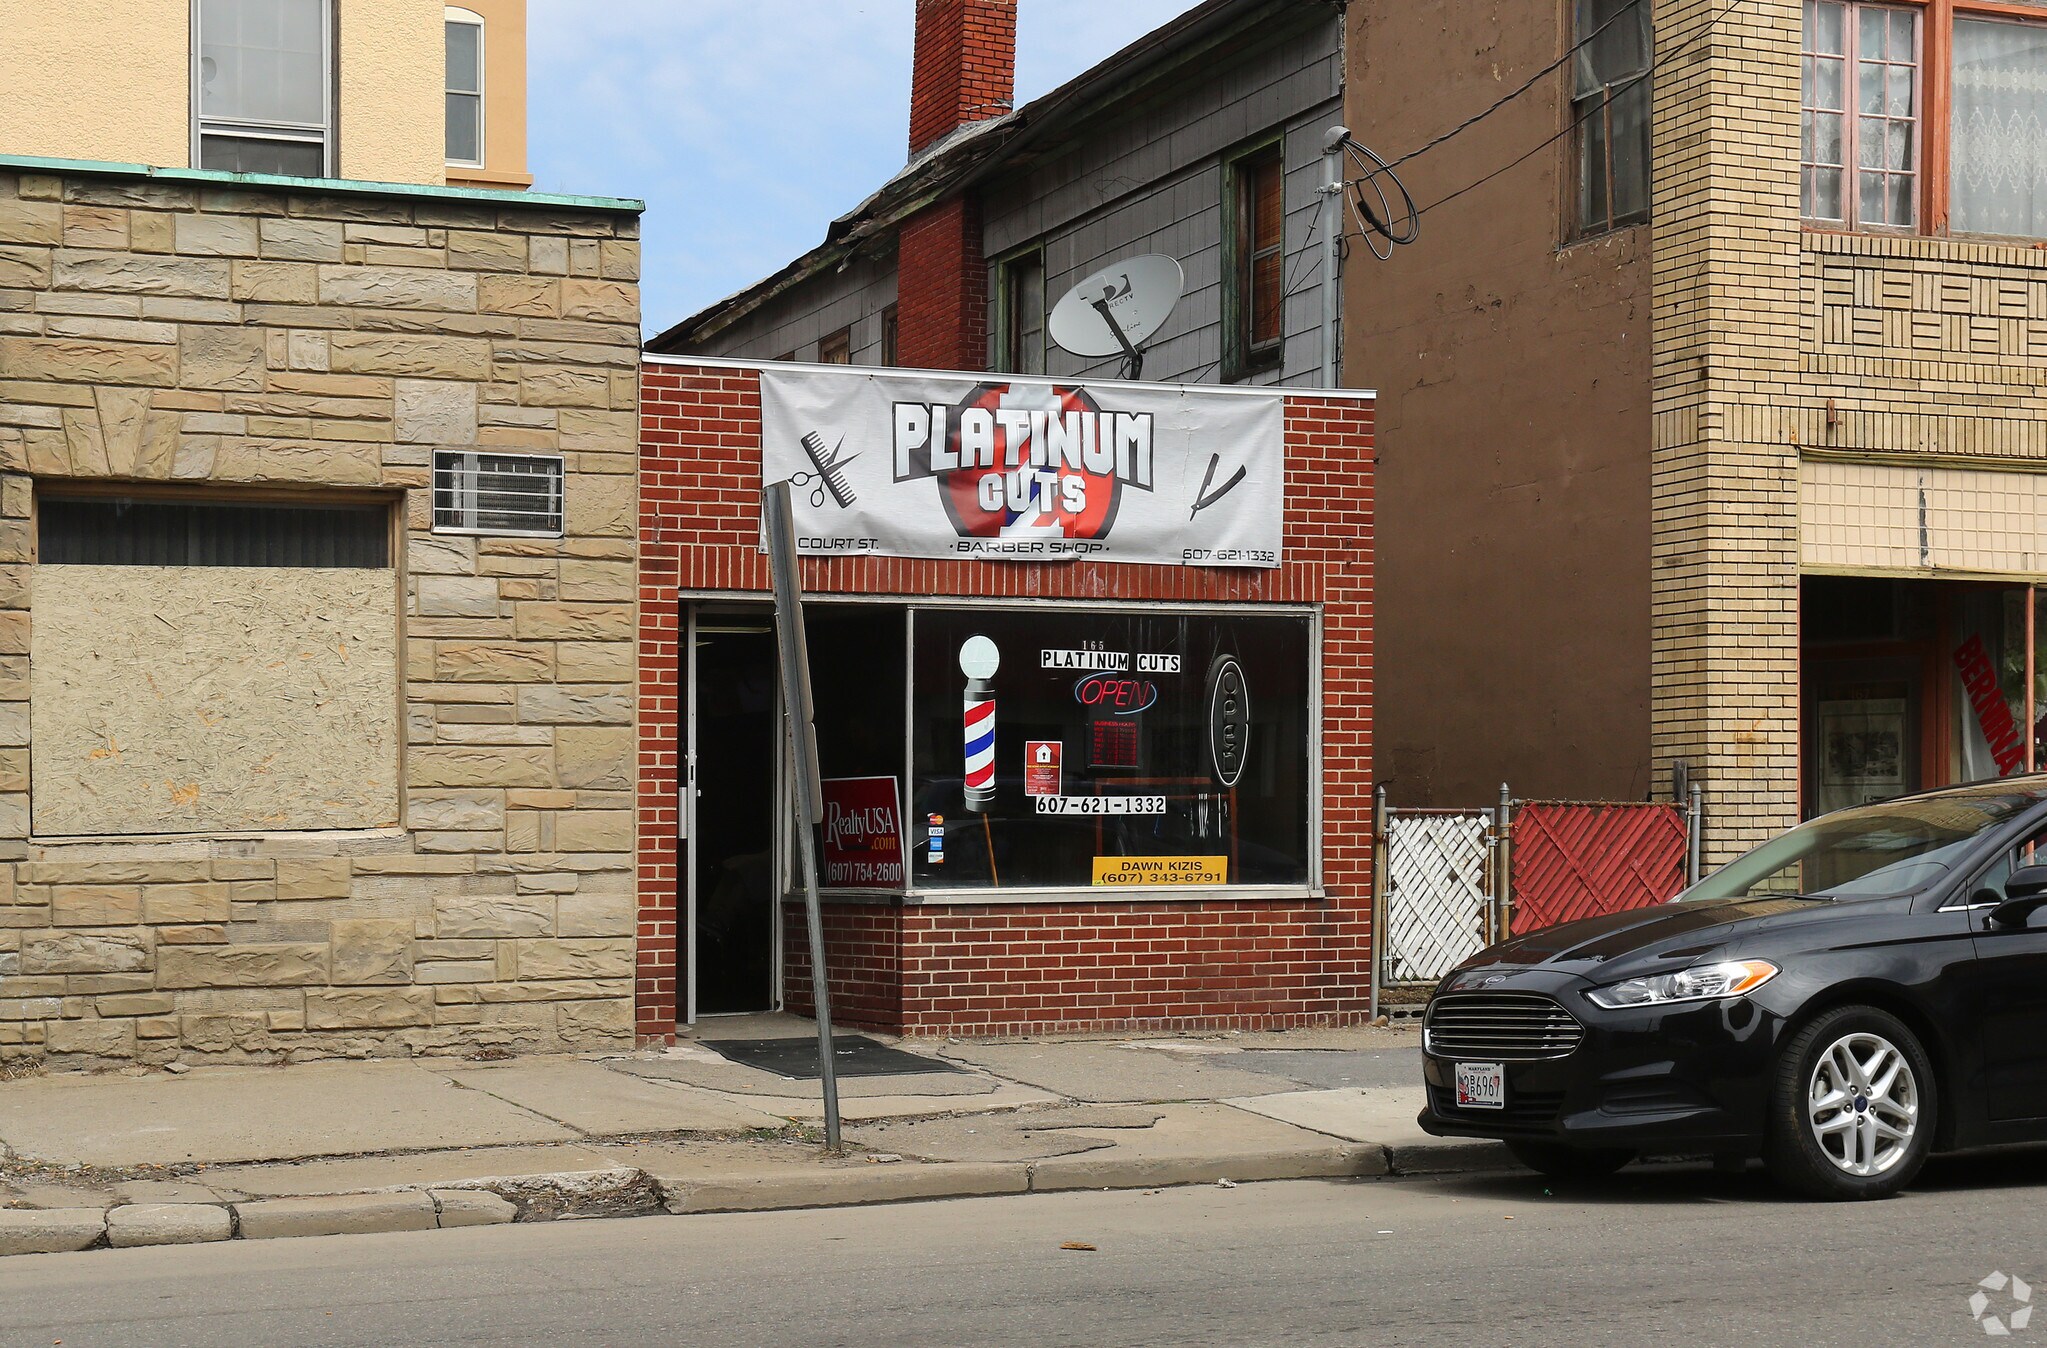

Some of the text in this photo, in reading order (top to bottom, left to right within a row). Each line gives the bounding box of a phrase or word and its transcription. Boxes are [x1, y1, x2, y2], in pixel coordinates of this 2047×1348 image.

[893, 401, 1153, 491] PLATINUM
[978, 471, 1086, 513] CUTS
[798, 537, 879, 550] COURT ST.
[956, 541, 1104, 554] BARBER SHOP
[1182, 548, 1275, 562] 607-621-1332
[1082, 640, 1104, 651] 165
[1042, 651, 1180, 671] PLATINUM CUTS
[1081, 679, 1149, 705] OPEN
[1953, 631, 2027, 778] BERNINA
[1037, 796, 1165, 813] 607-621-1332
[825, 801, 896, 851] RealtyUSA
[871, 836, 896, 850] .com
[828, 861, 901, 883] (607) 754-2600
[1121, 862, 1203, 872] DAWN KIZIS
[1101, 872, 1221, 883] (607) 343-6791
